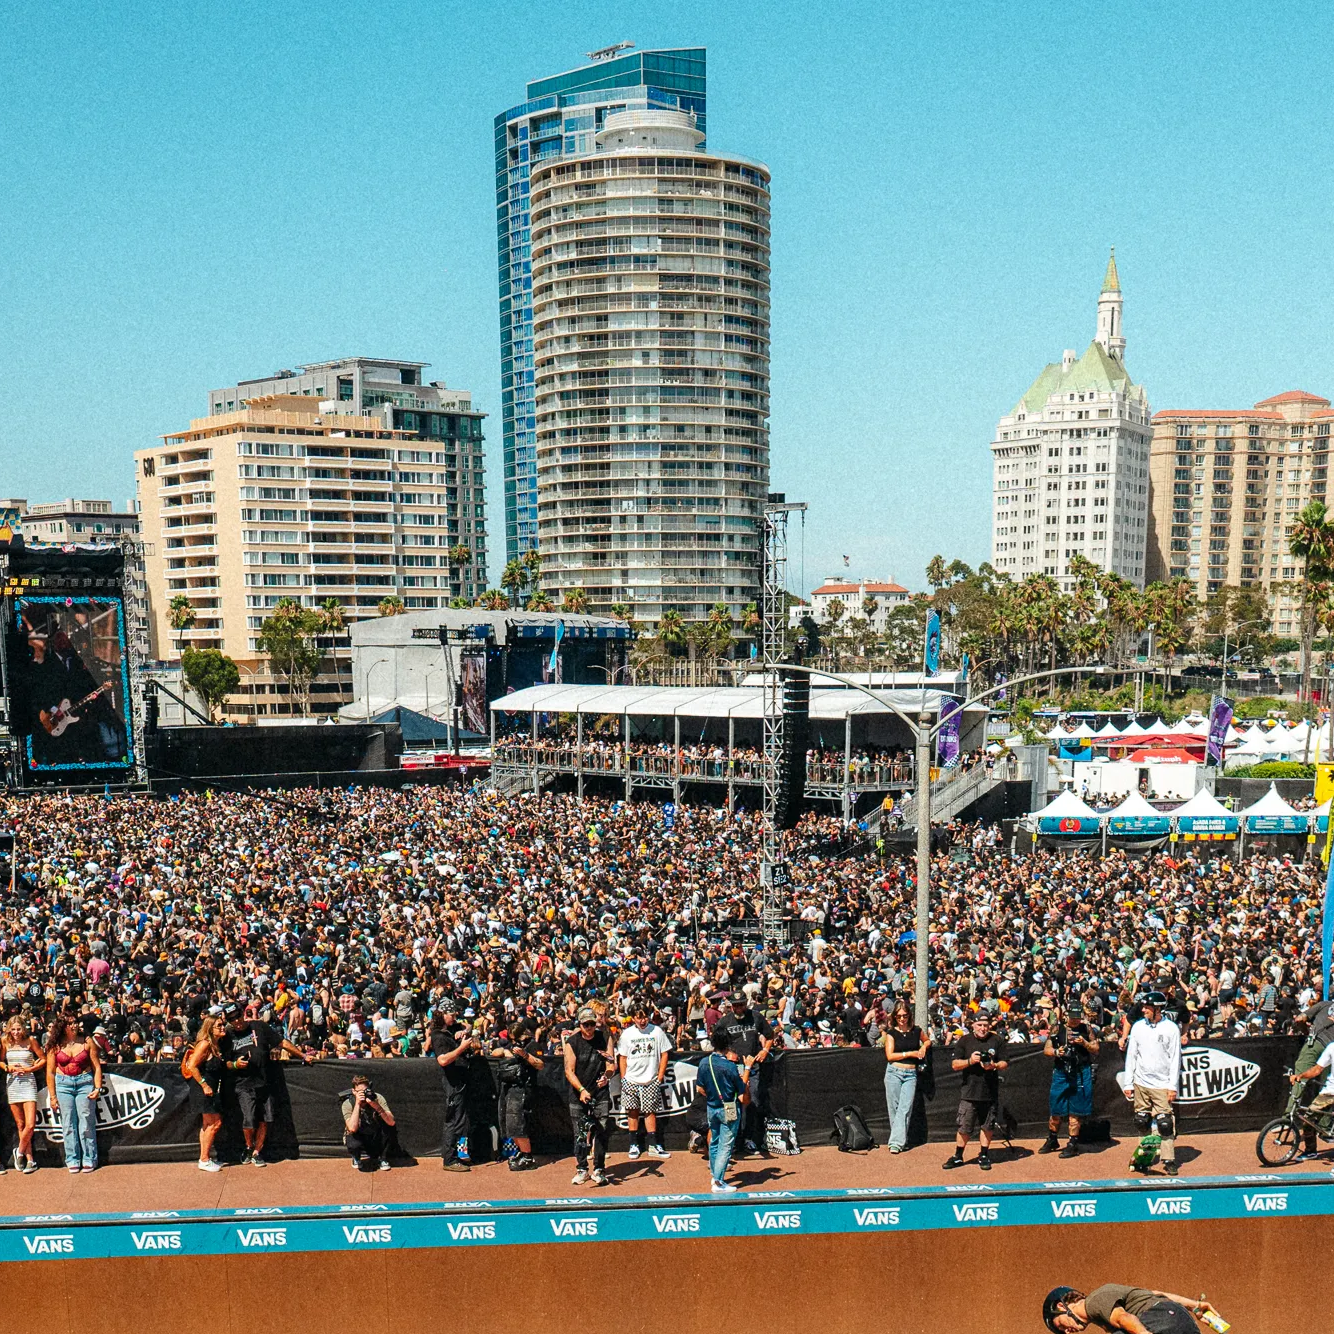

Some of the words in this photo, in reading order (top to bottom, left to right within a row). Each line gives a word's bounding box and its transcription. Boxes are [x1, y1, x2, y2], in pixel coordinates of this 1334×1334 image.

[1179, 1072, 1202, 1097] HE
[23, 1234, 74, 1253] VANS
[131, 1231, 181, 1249] VANS
[237, 1228, 287, 1246] VANS
[343, 1224, 392, 1243] VANS
[447, 1221, 496, 1240] VANS
[550, 1218, 598, 1236] VANS
[653, 1214, 700, 1232] VANS
[754, 1210, 801, 1228] VANS
[853, 1207, 900, 1225] VANS
[953, 1203, 999, 1221] VANS
[1051, 1200, 1097, 1217] VANS
[1147, 1197, 1192, 1214] VANS
[1243, 1193, 1288, 1211] VANS
